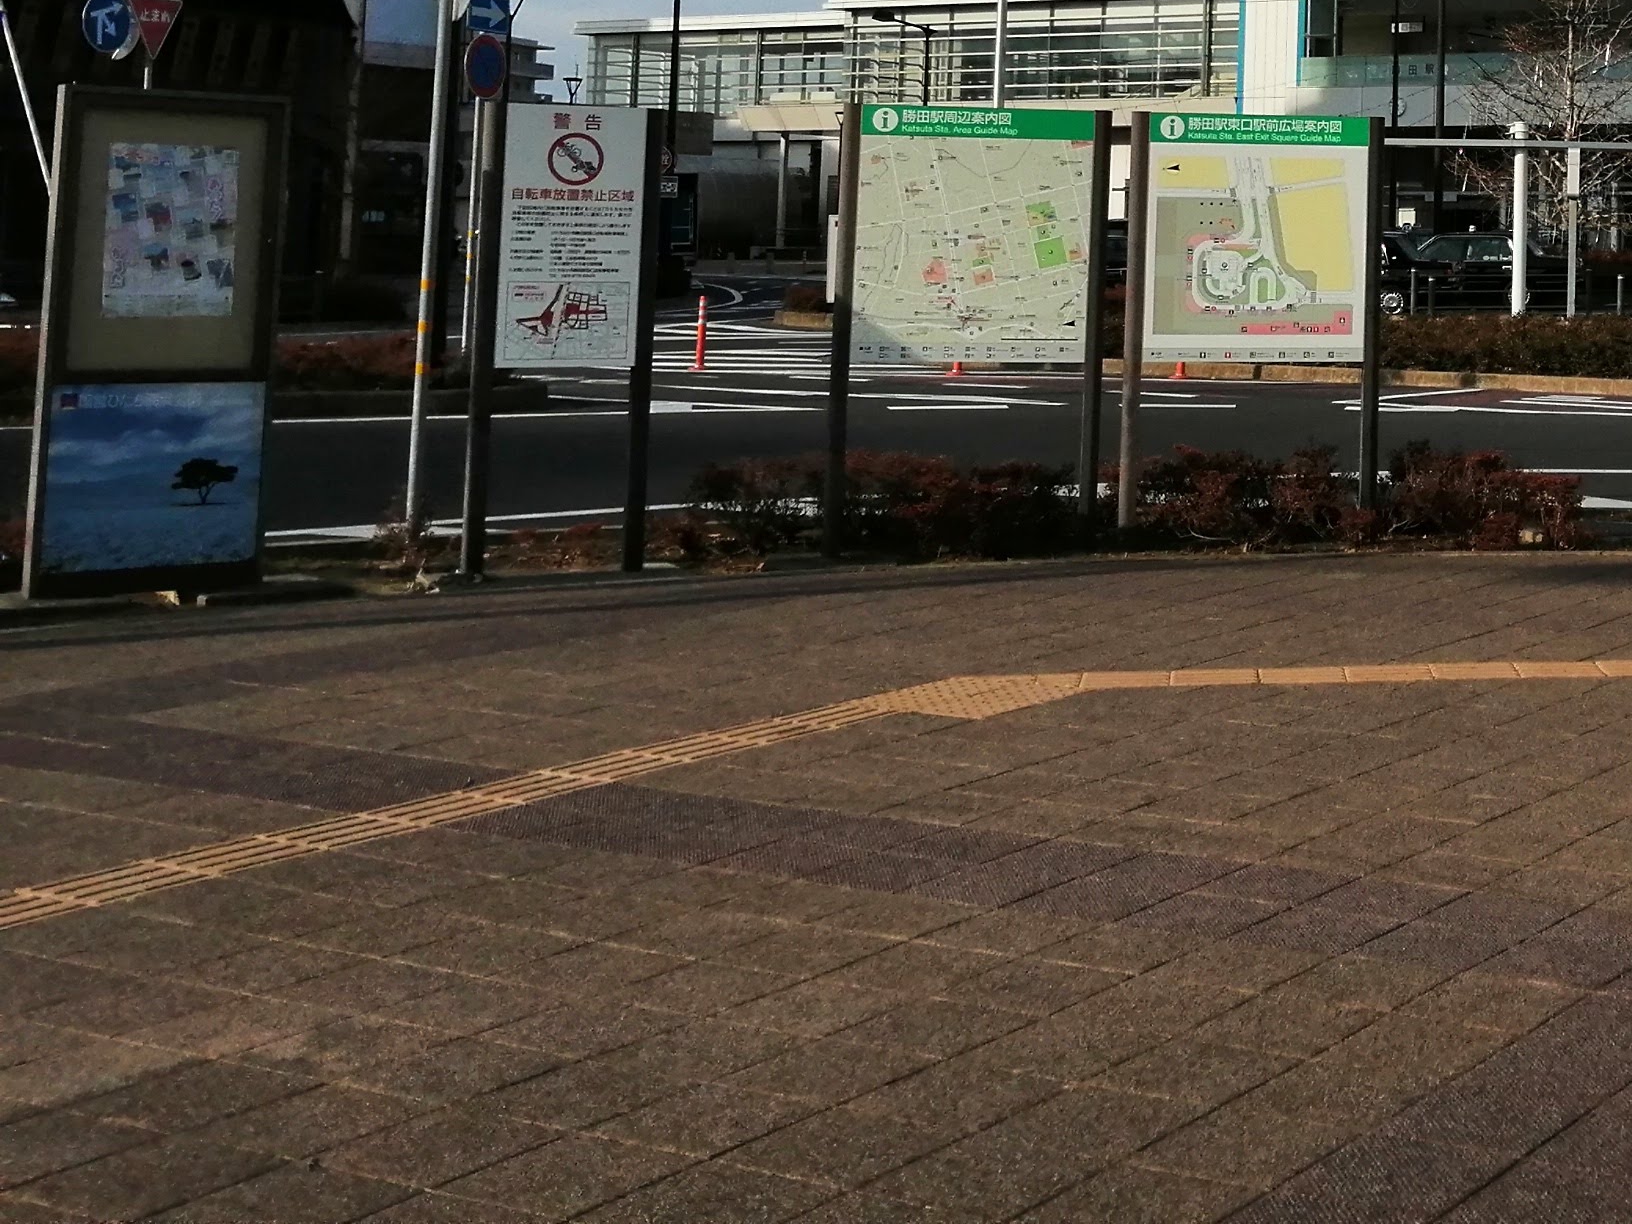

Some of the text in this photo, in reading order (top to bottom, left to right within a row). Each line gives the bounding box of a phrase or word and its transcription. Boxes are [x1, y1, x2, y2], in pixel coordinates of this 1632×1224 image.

[140, 7, 171, 23] 止まれ
[553, 112, 603, 131] 警告
[901, 109, 1012, 125] 勝田駅周辺案内図
[1188, 116, 1342, 133] 勝田駅東口駅前広場案内図
[901, 124, 1018, 136] Katsuta Sta. Area Guide Map
[1188, 132, 1341, 143] Katsuta Sta. East Exit Square Guide Map
[511, 187, 635, 203] 自転車放置禁止区域
